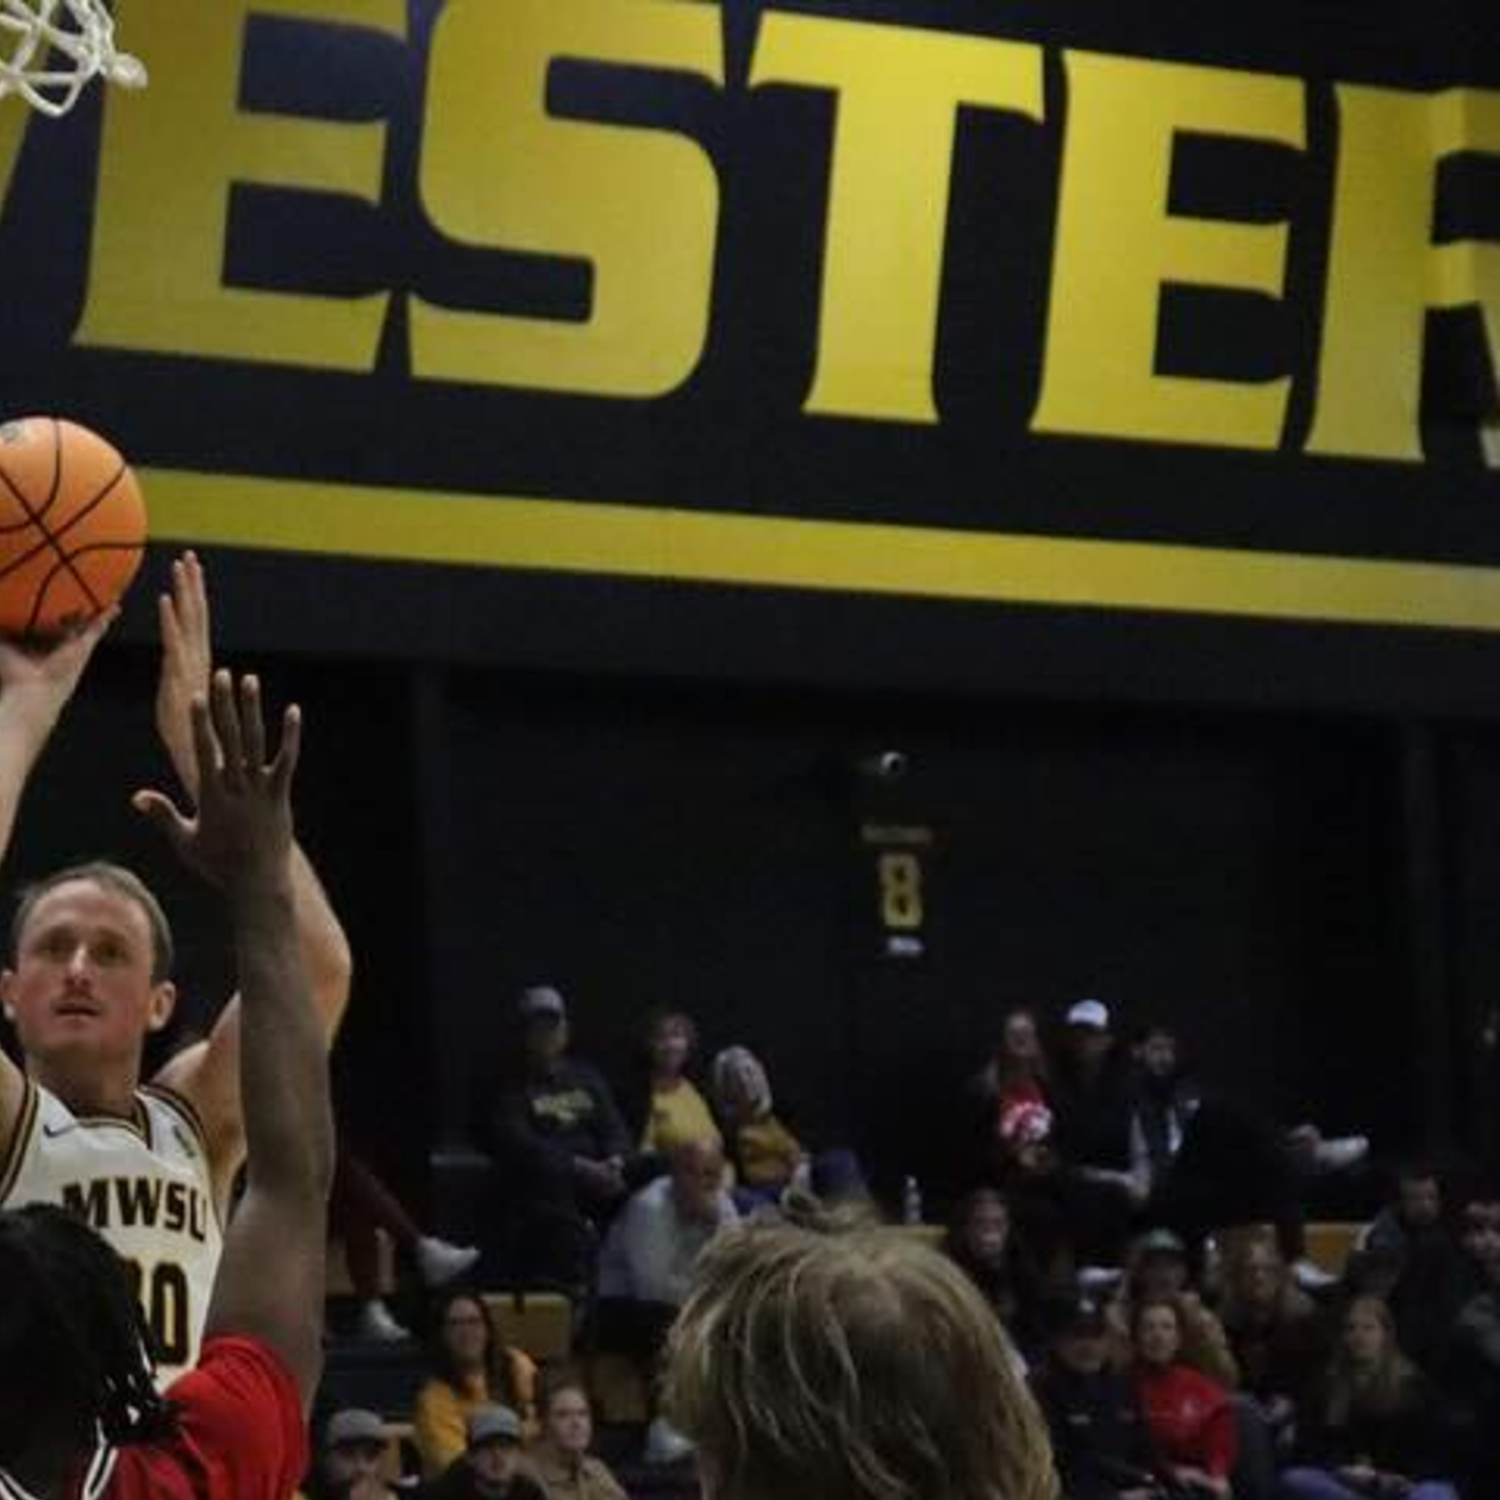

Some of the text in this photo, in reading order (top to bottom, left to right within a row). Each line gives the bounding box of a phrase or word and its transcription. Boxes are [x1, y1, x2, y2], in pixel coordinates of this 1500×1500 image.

[878, 851, 924, 928] 8
[61, 1176, 208, 1243] MWSU
[117, 1256, 190, 1367] 0
